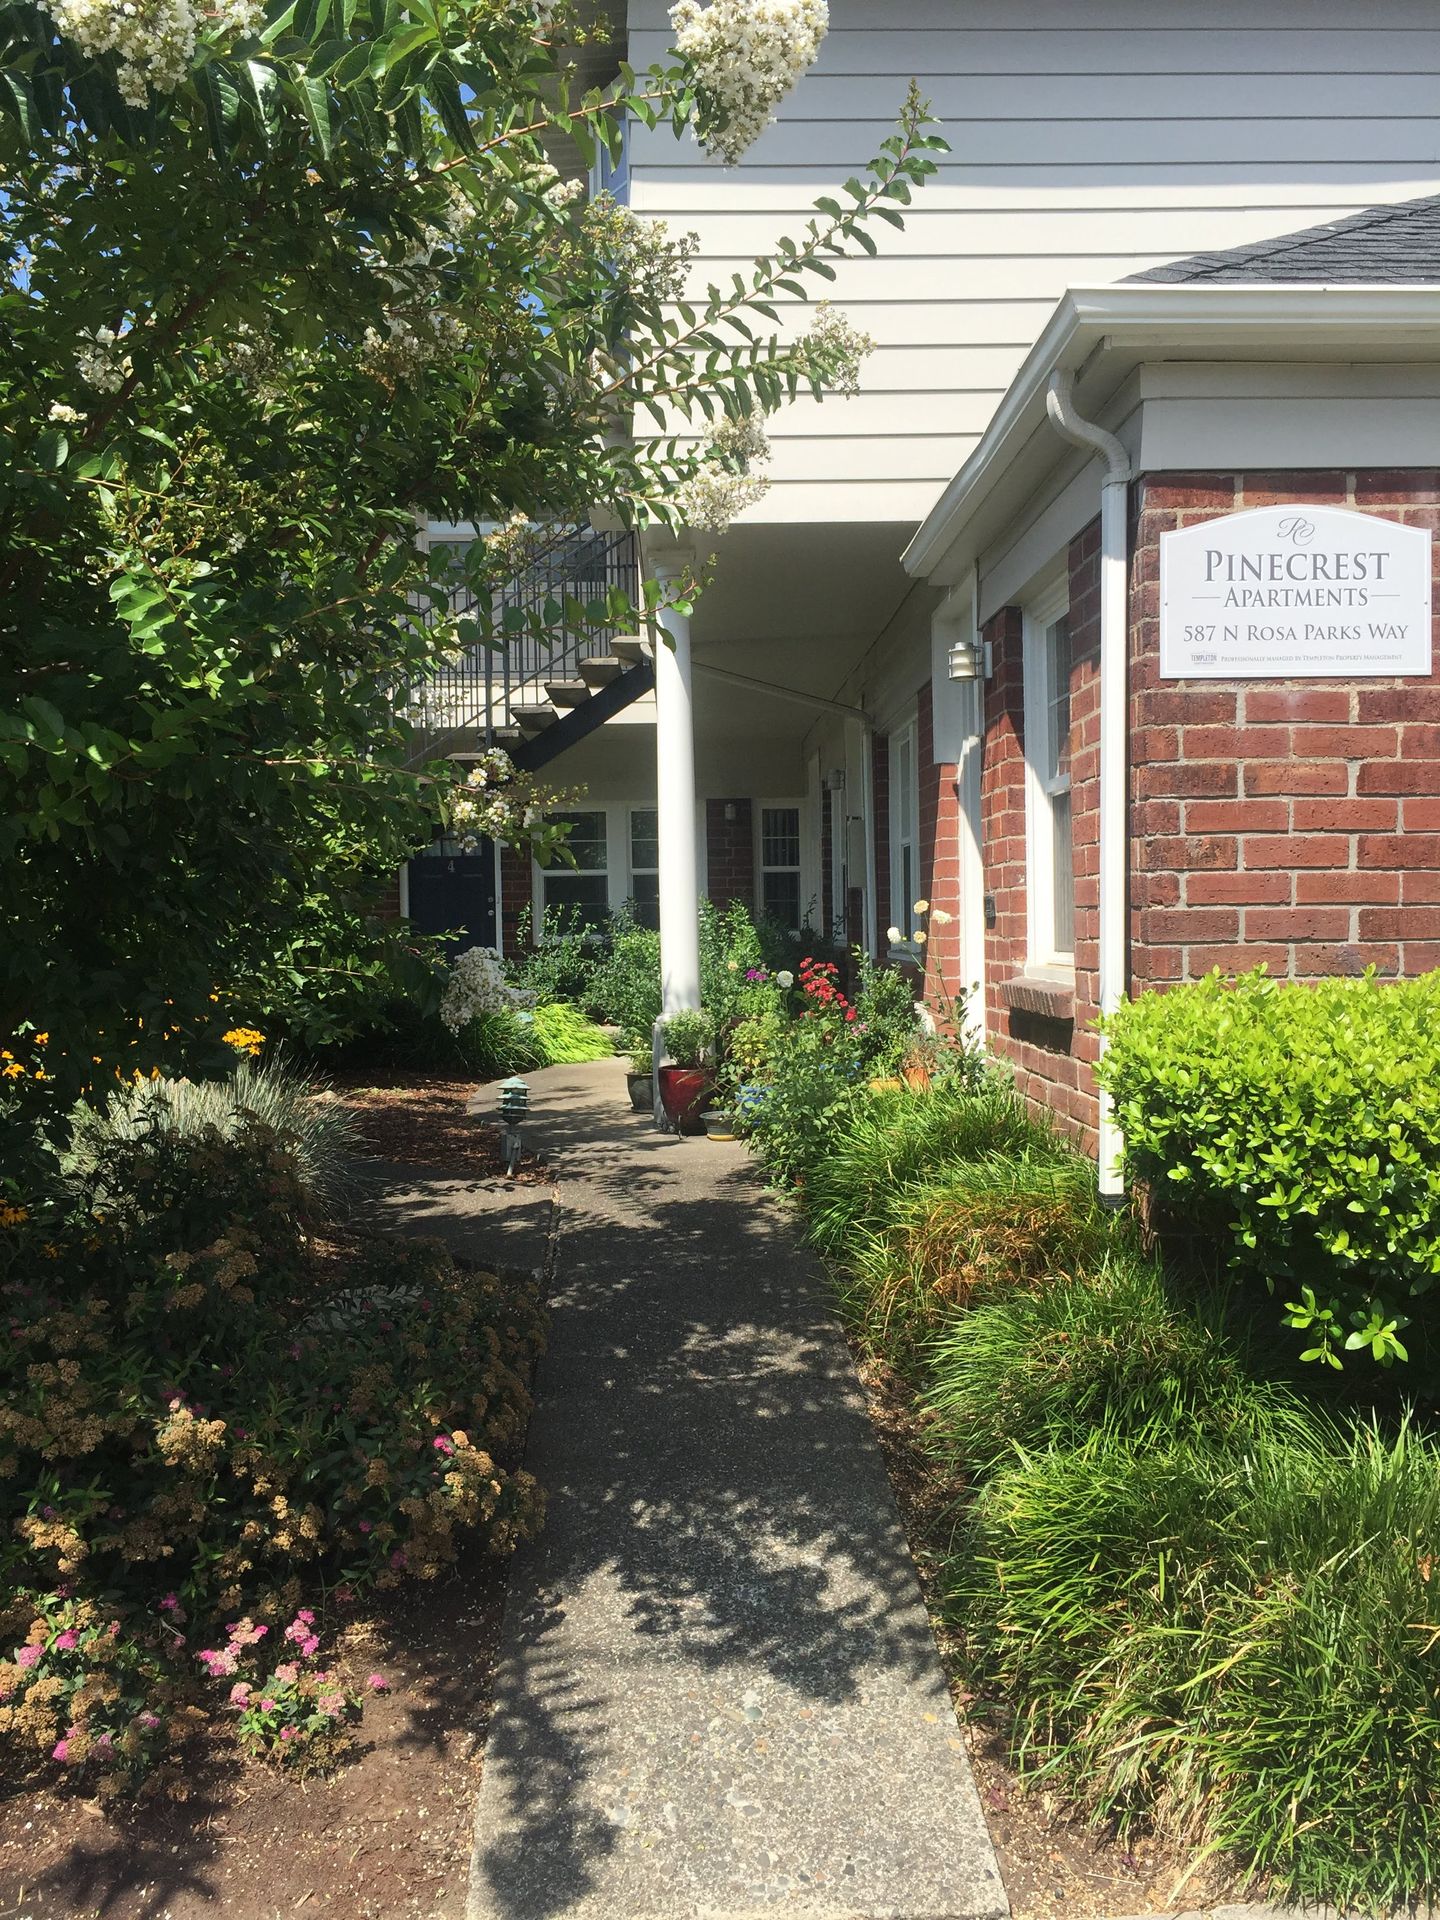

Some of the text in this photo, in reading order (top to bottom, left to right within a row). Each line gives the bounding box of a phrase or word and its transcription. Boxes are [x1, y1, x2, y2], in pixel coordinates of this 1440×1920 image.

[1204, 550, 1389, 582] PINECREST
[1224, 587, 1368, 608] APARTMENTS
[1183, 623, 1409, 642] 587 N ROSA PARKS WAY
